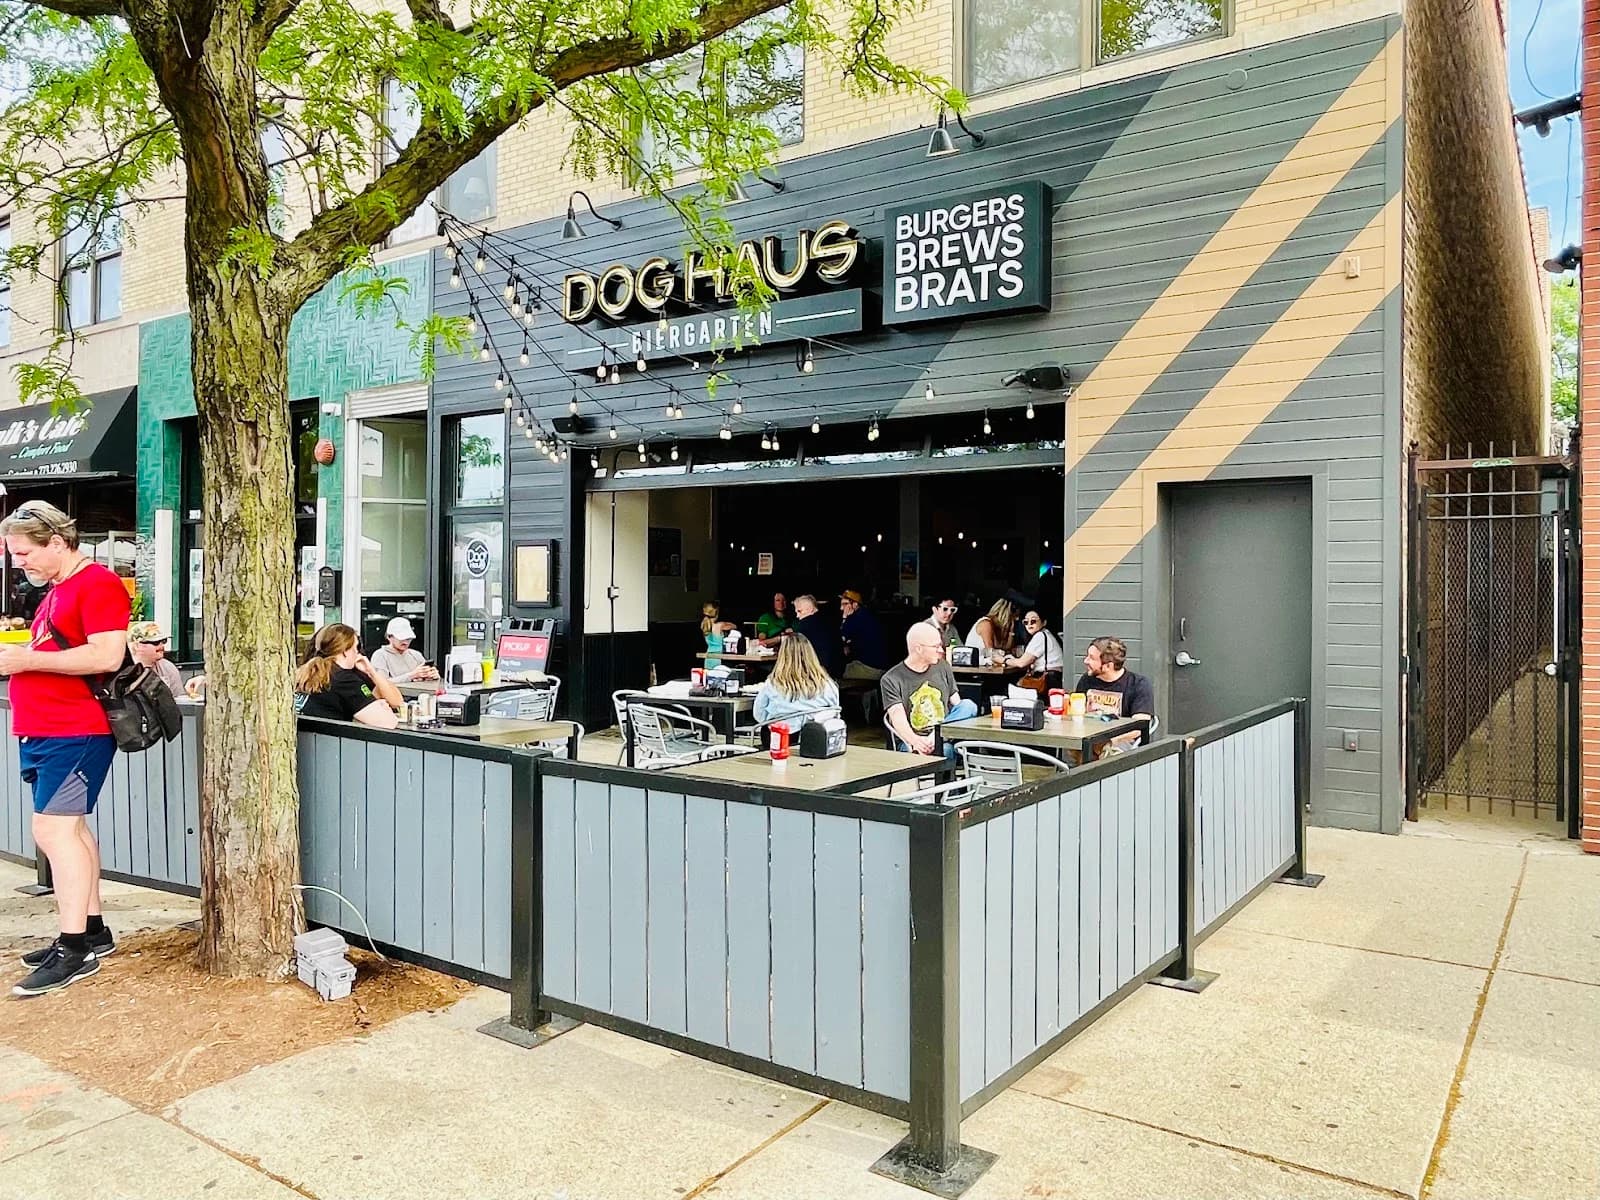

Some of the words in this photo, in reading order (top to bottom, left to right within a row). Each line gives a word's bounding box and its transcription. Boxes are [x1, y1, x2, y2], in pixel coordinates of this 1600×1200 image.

[896, 194, 1025, 241] BURGERS
[563, 255, 675, 322] DOG
[684, 220, 859, 303] HAUS
[895, 222, 1025, 275] BREWS
[895, 259, 1025, 313] BRATS
[632, 310, 773, 354] BIERGARTEN
